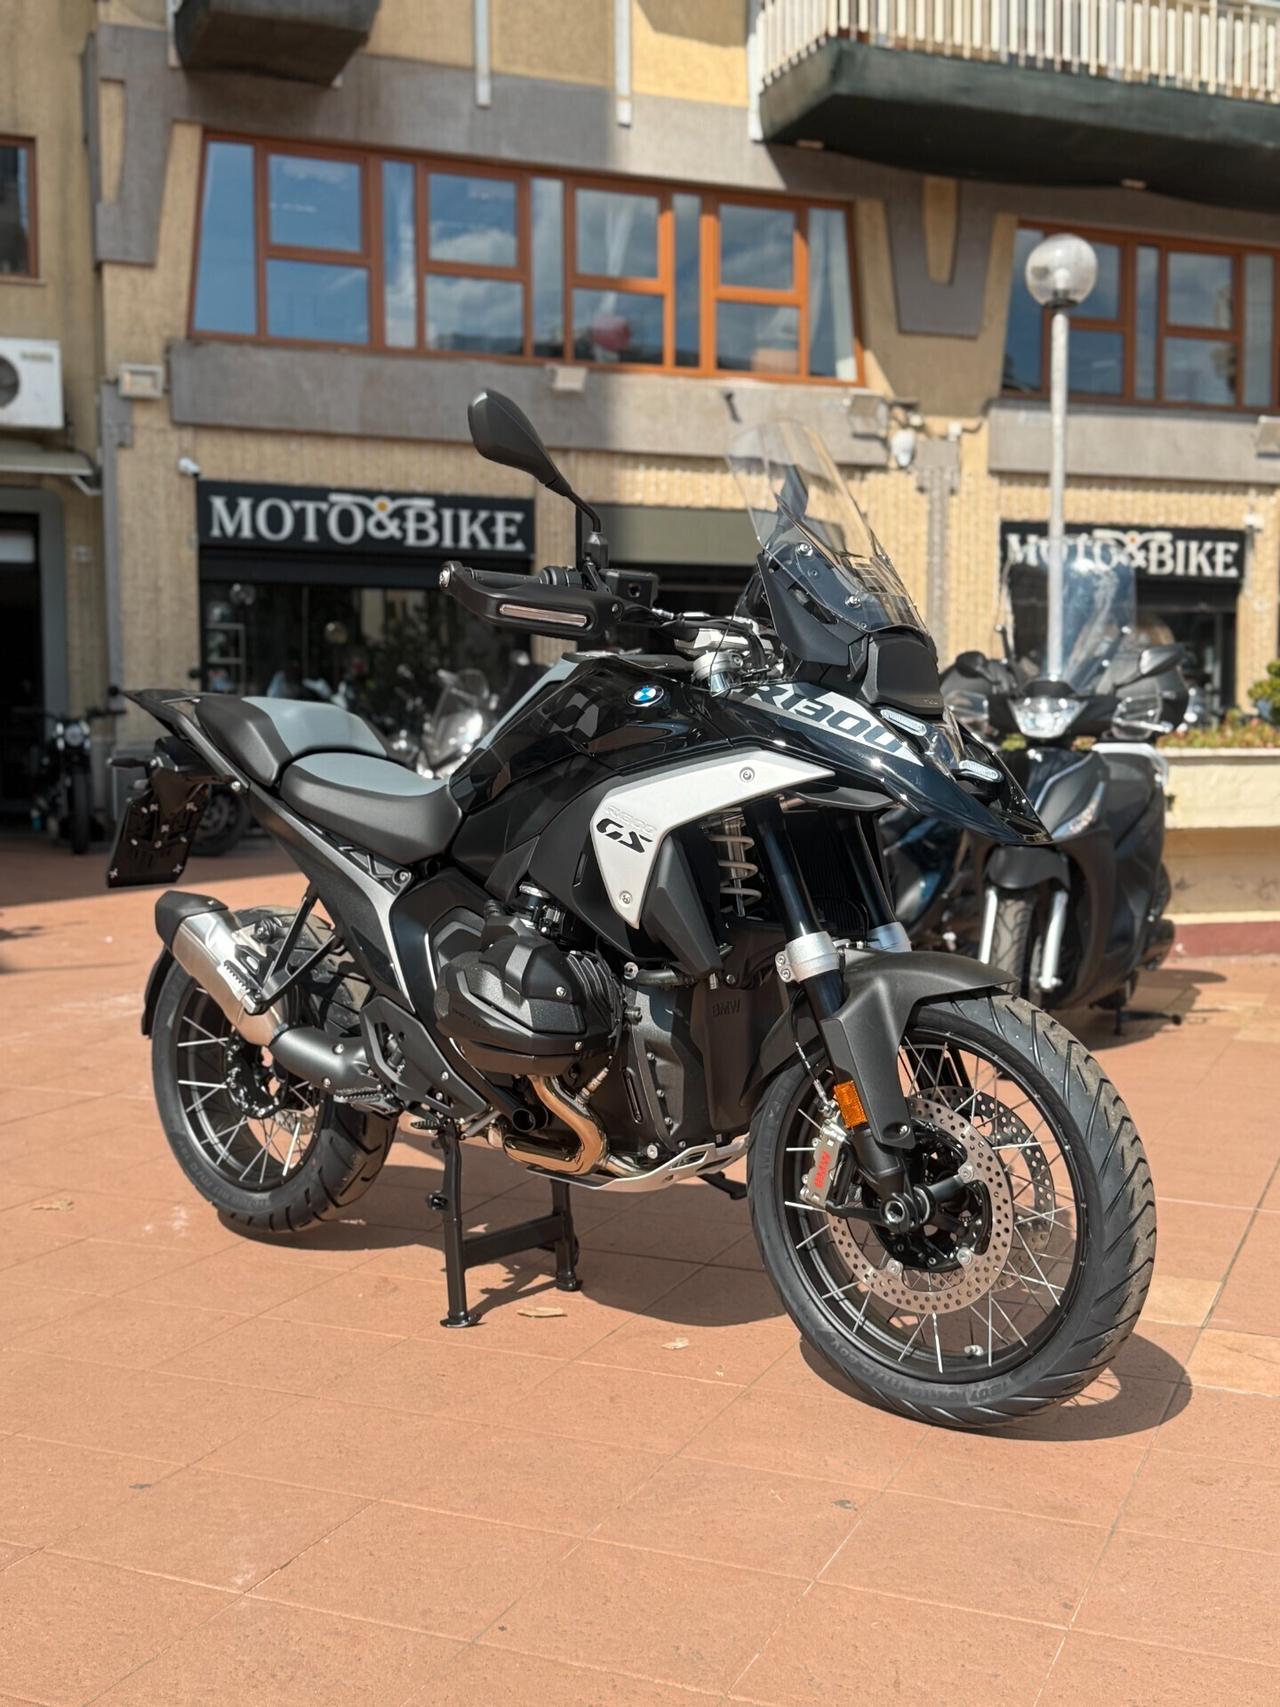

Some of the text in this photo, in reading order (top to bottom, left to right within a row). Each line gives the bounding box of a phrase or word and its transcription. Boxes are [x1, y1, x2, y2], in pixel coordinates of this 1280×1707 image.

[210, 494, 526, 551] MOTO&BIKE
[596, 818, 653, 853] GS
[712, 1000, 740, 1017] BMW
